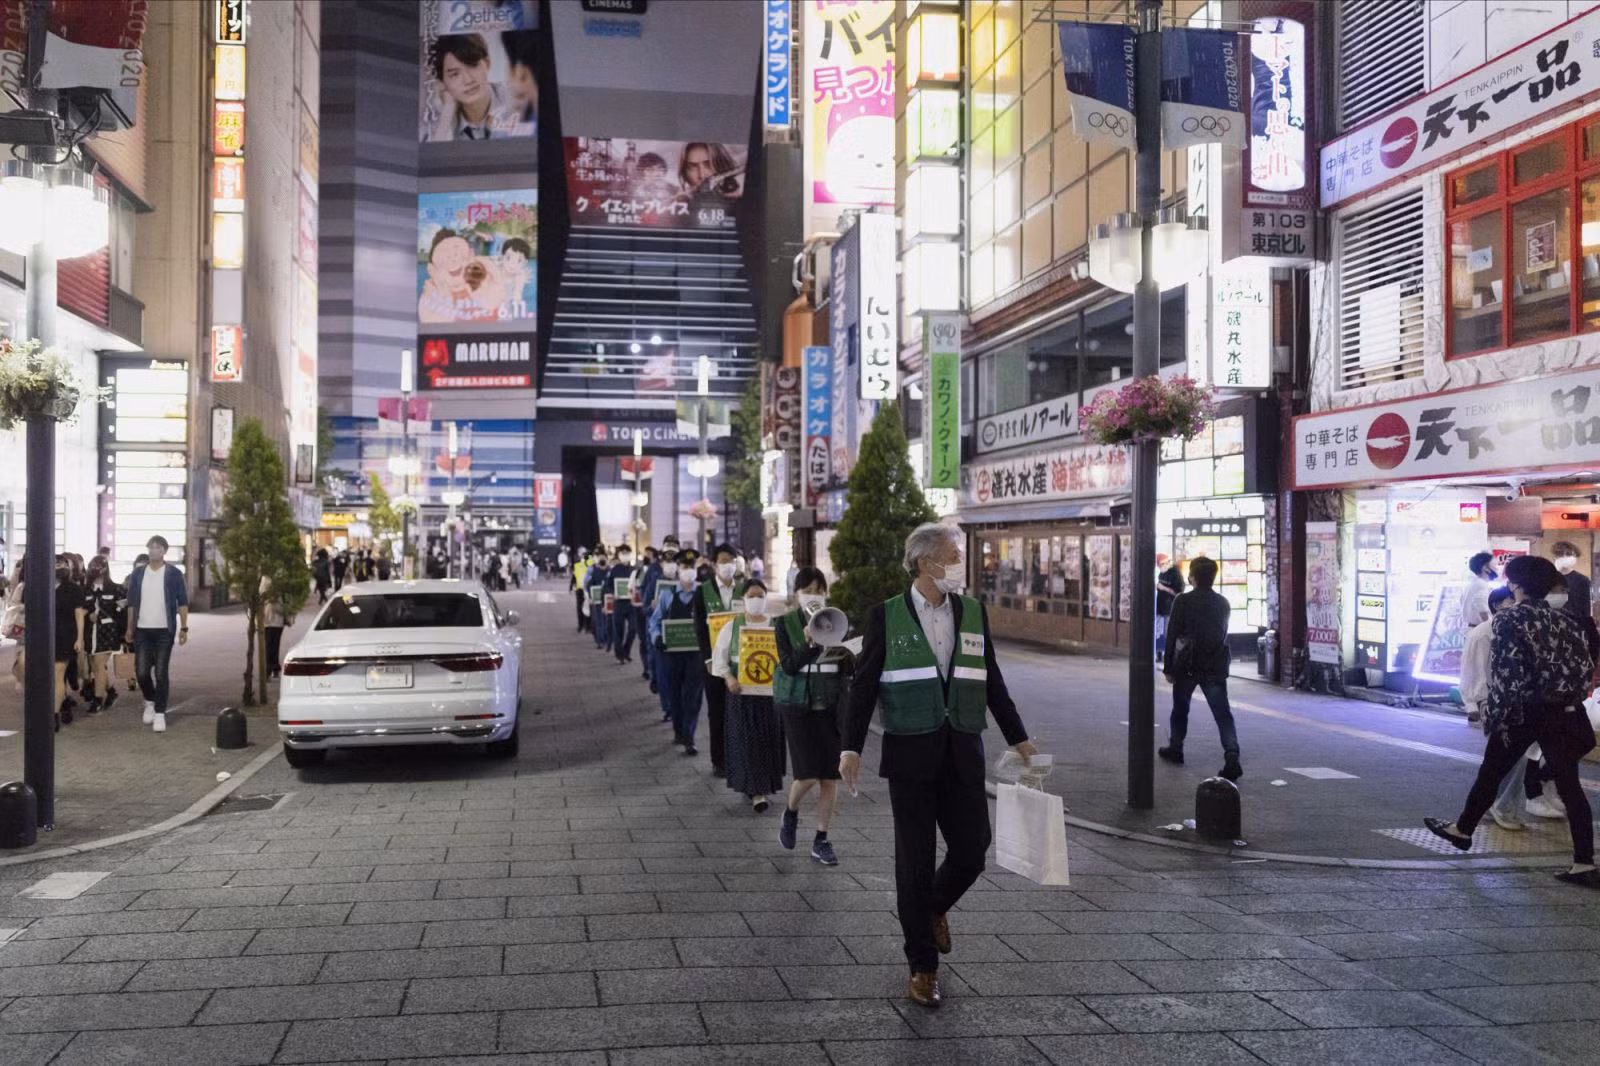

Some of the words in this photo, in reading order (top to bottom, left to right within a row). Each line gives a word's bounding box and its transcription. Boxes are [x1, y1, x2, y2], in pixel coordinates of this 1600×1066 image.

[1123, 38, 1134, 78] TOKYO
[1222, 41, 1238, 77] TOKYO
[1226, 76, 1239, 108] 2020
[1422, 39, 1582, 152] 天下一品
[1464, 64, 1524, 98] TENKAIPPIN
[1326, 138, 1374, 171] 中華そば
[1252, 212, 1306, 229] 第103
[1252, 232, 1306, 254] 東京ビル
[1218, 291, 1264, 303] ルノアール
[455, 341, 530, 362] MARUHAN
[810, 350, 829, 435] カラオケ
[1305, 425, 1359, 448] 中華そば
[1415, 385, 1600, 462] 天下一品
[1305, 449, 1359, 471] 専門店
